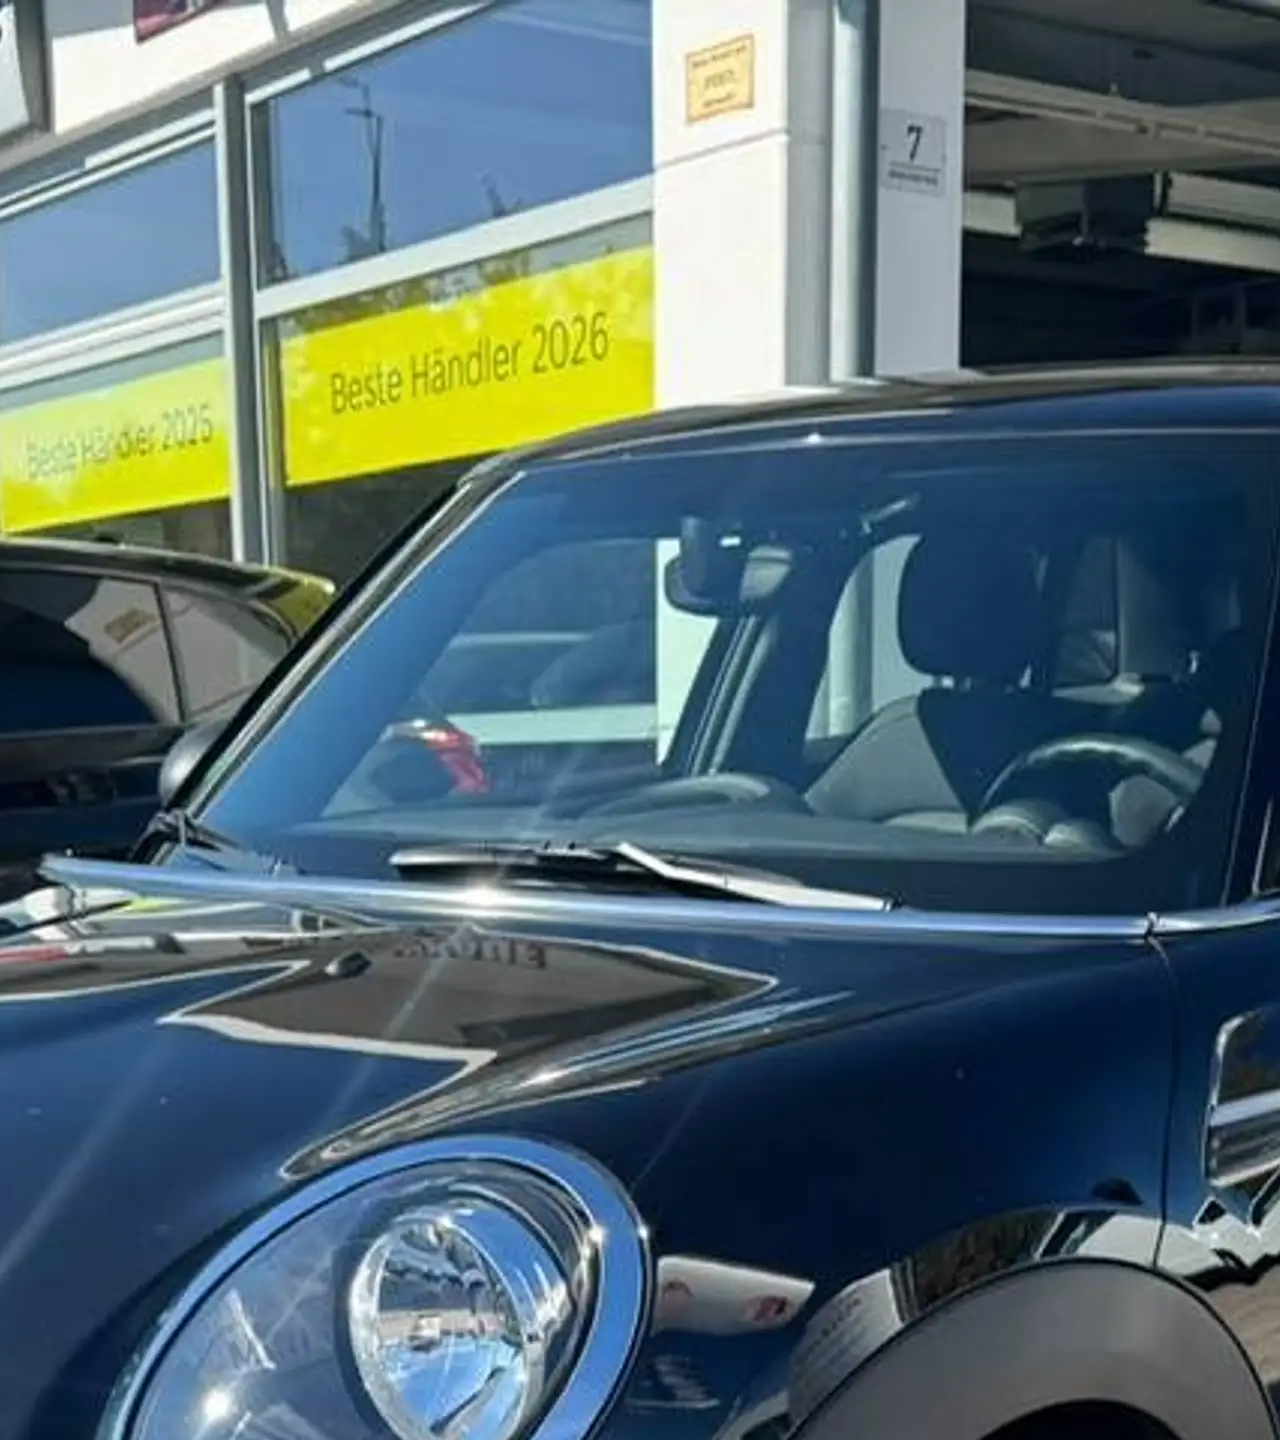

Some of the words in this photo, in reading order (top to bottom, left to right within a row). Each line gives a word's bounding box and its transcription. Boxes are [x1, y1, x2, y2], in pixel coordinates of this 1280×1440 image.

[906, 125, 924, 163] 7
[330, 361, 403, 414] Beste
[411, 334, 522, 398] Händler
[531, 311, 609, 374] 2026
